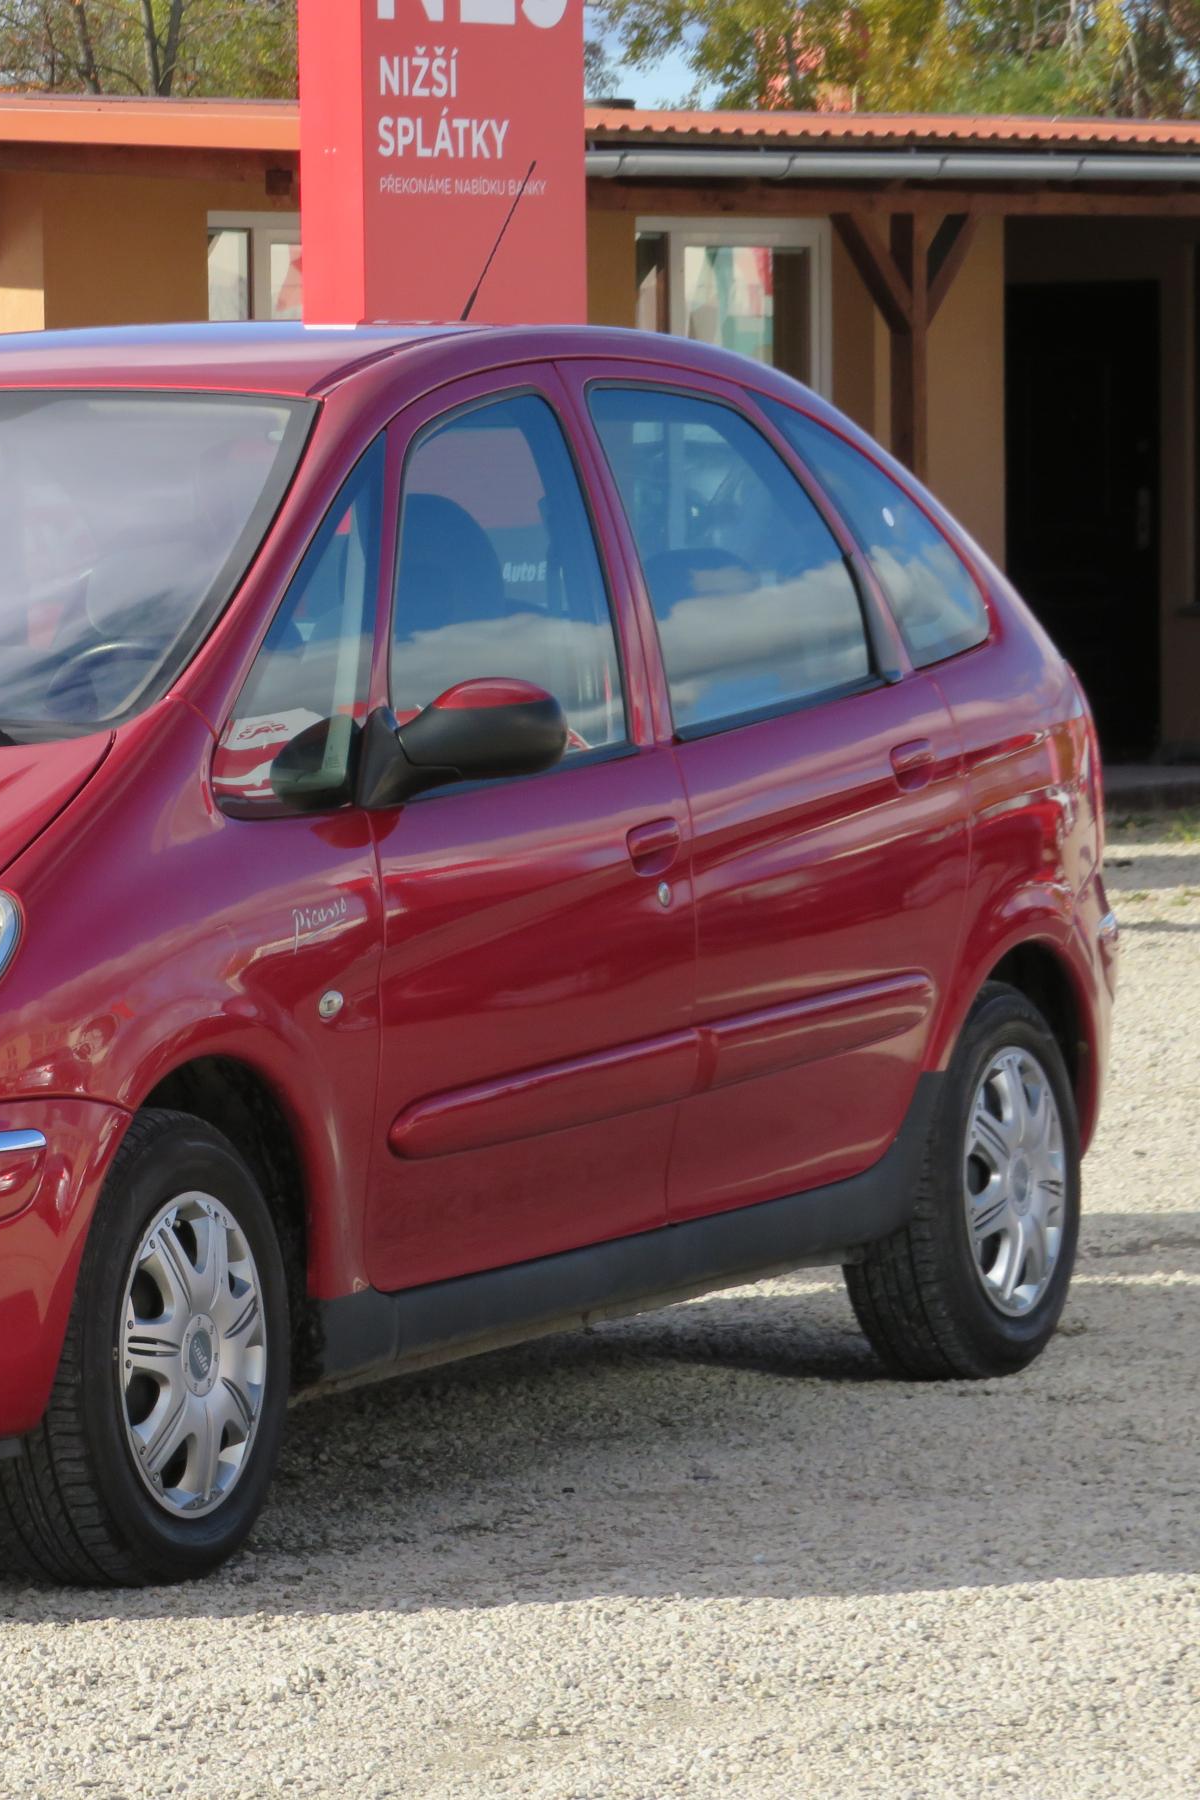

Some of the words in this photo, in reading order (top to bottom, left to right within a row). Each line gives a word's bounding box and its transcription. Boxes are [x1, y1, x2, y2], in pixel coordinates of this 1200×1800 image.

[379, 46, 459, 98] NIŽŠÍ
[377, 107, 510, 160] SPLÁTKY
[379, 174, 452, 195] PŘEKONÁME
[455, 175, 506, 196] NABÍDKU
[508, 179, 547, 196] BANKY
